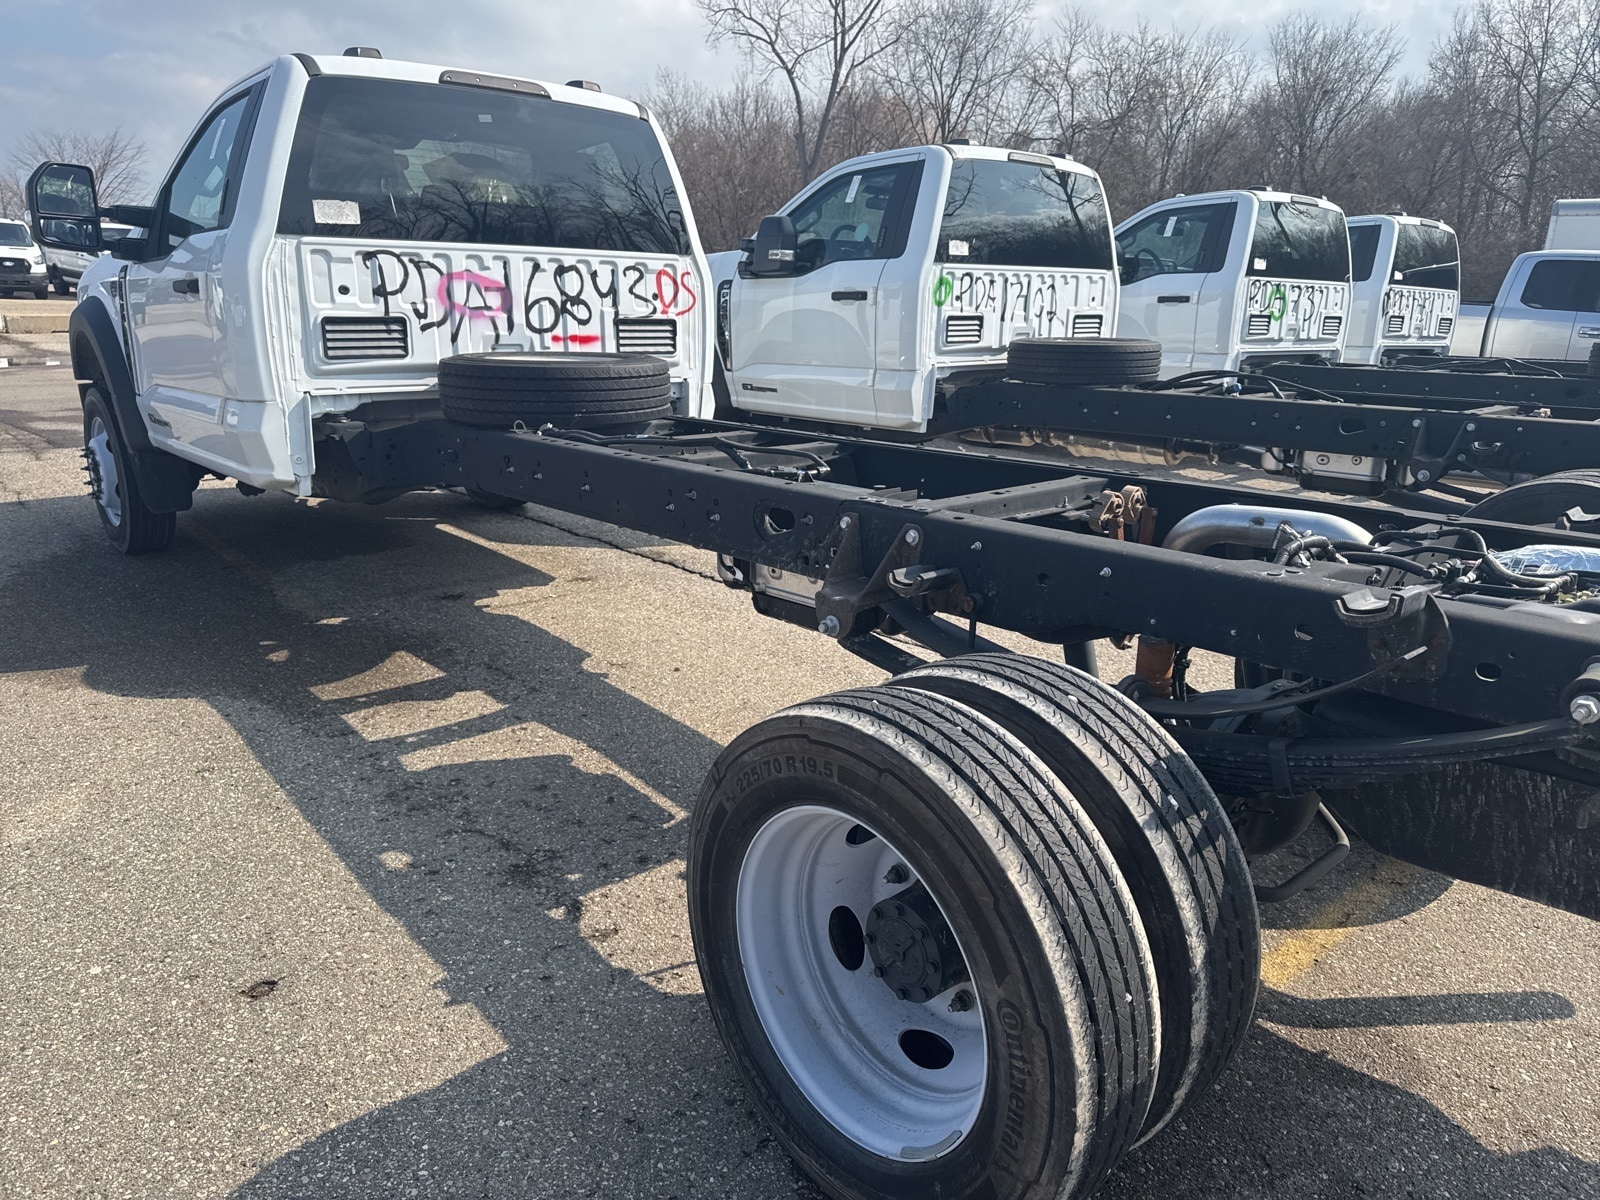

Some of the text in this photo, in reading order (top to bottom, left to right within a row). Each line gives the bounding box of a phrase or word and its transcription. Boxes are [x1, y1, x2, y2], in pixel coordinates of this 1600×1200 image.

[363, 249, 657, 346] PDA16843
[736, 757, 783, 793] 225/70
[997, 1000, 1033, 1165] Continental
